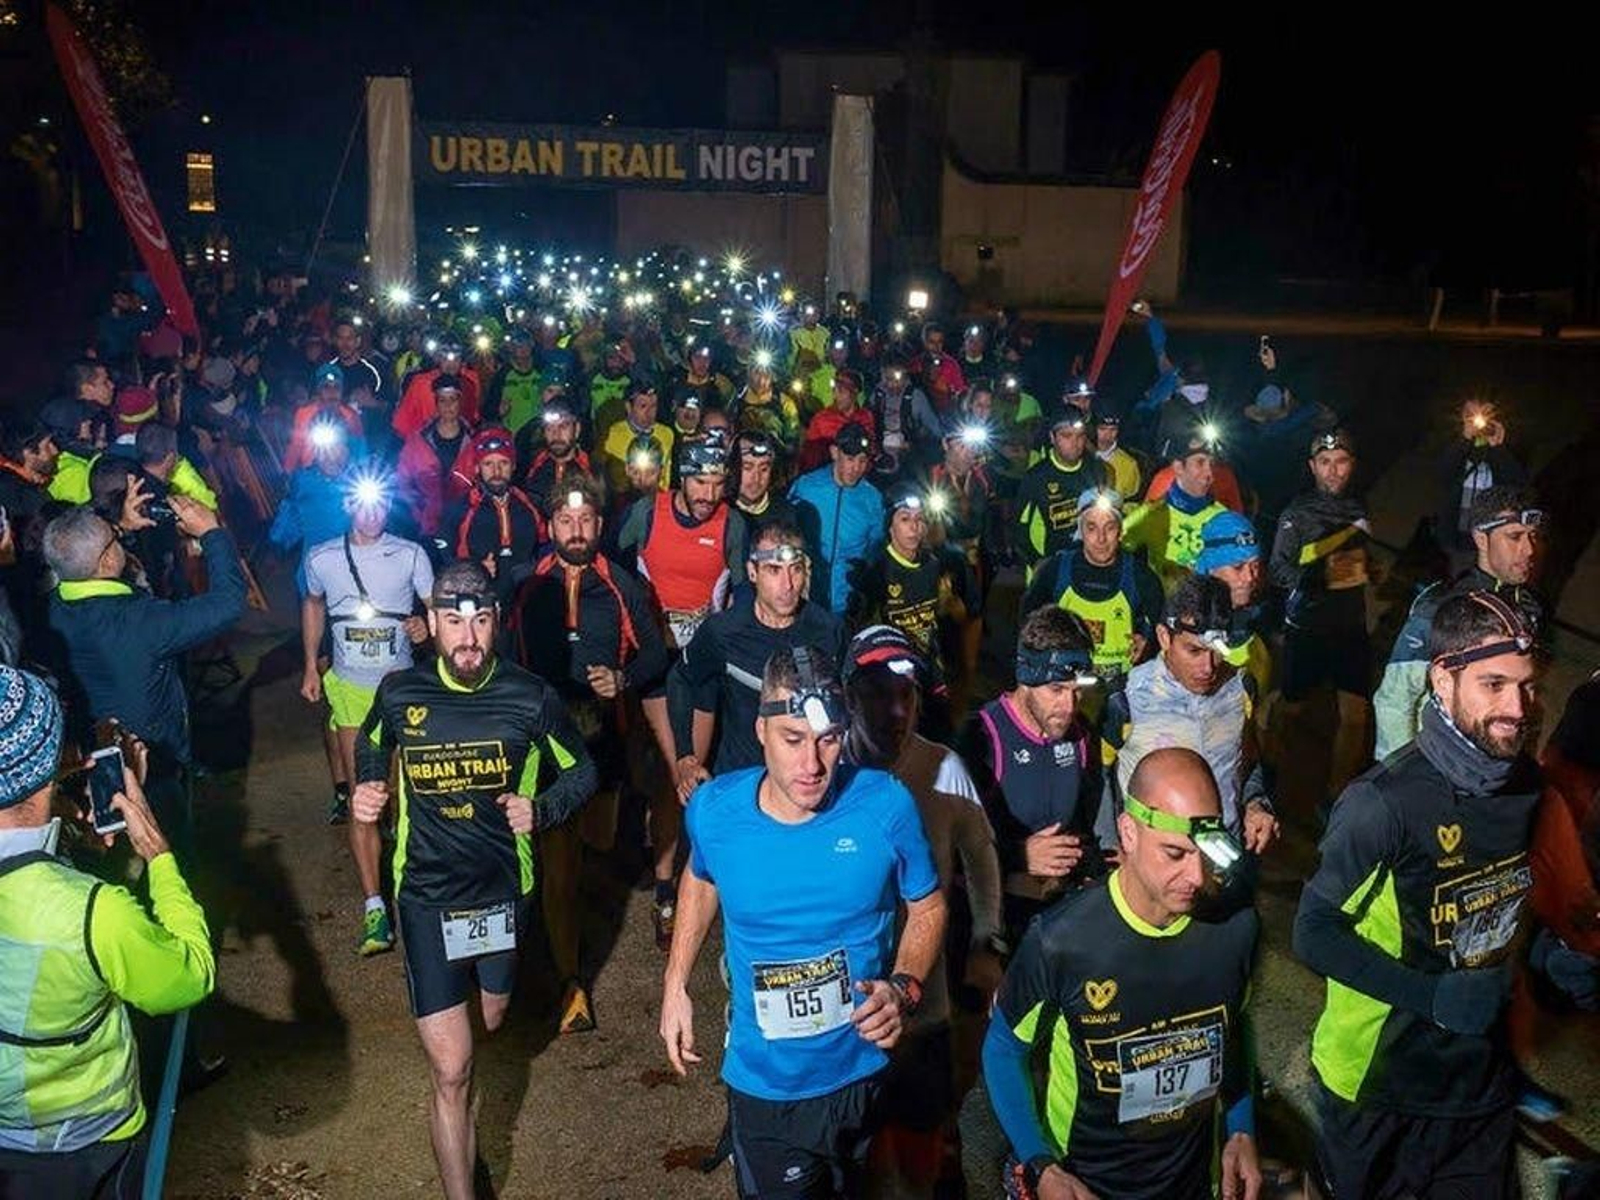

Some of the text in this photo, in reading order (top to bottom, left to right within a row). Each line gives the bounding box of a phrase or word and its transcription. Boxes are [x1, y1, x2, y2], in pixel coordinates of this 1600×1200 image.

[429, 136, 815, 182] URBAN TRAIL NIGHT
[461, 757, 513, 777] TRAIL
[468, 917, 488, 940] 26
[786, 987, 823, 1018] 155
[1154, 1063, 1191, 1097] 137
